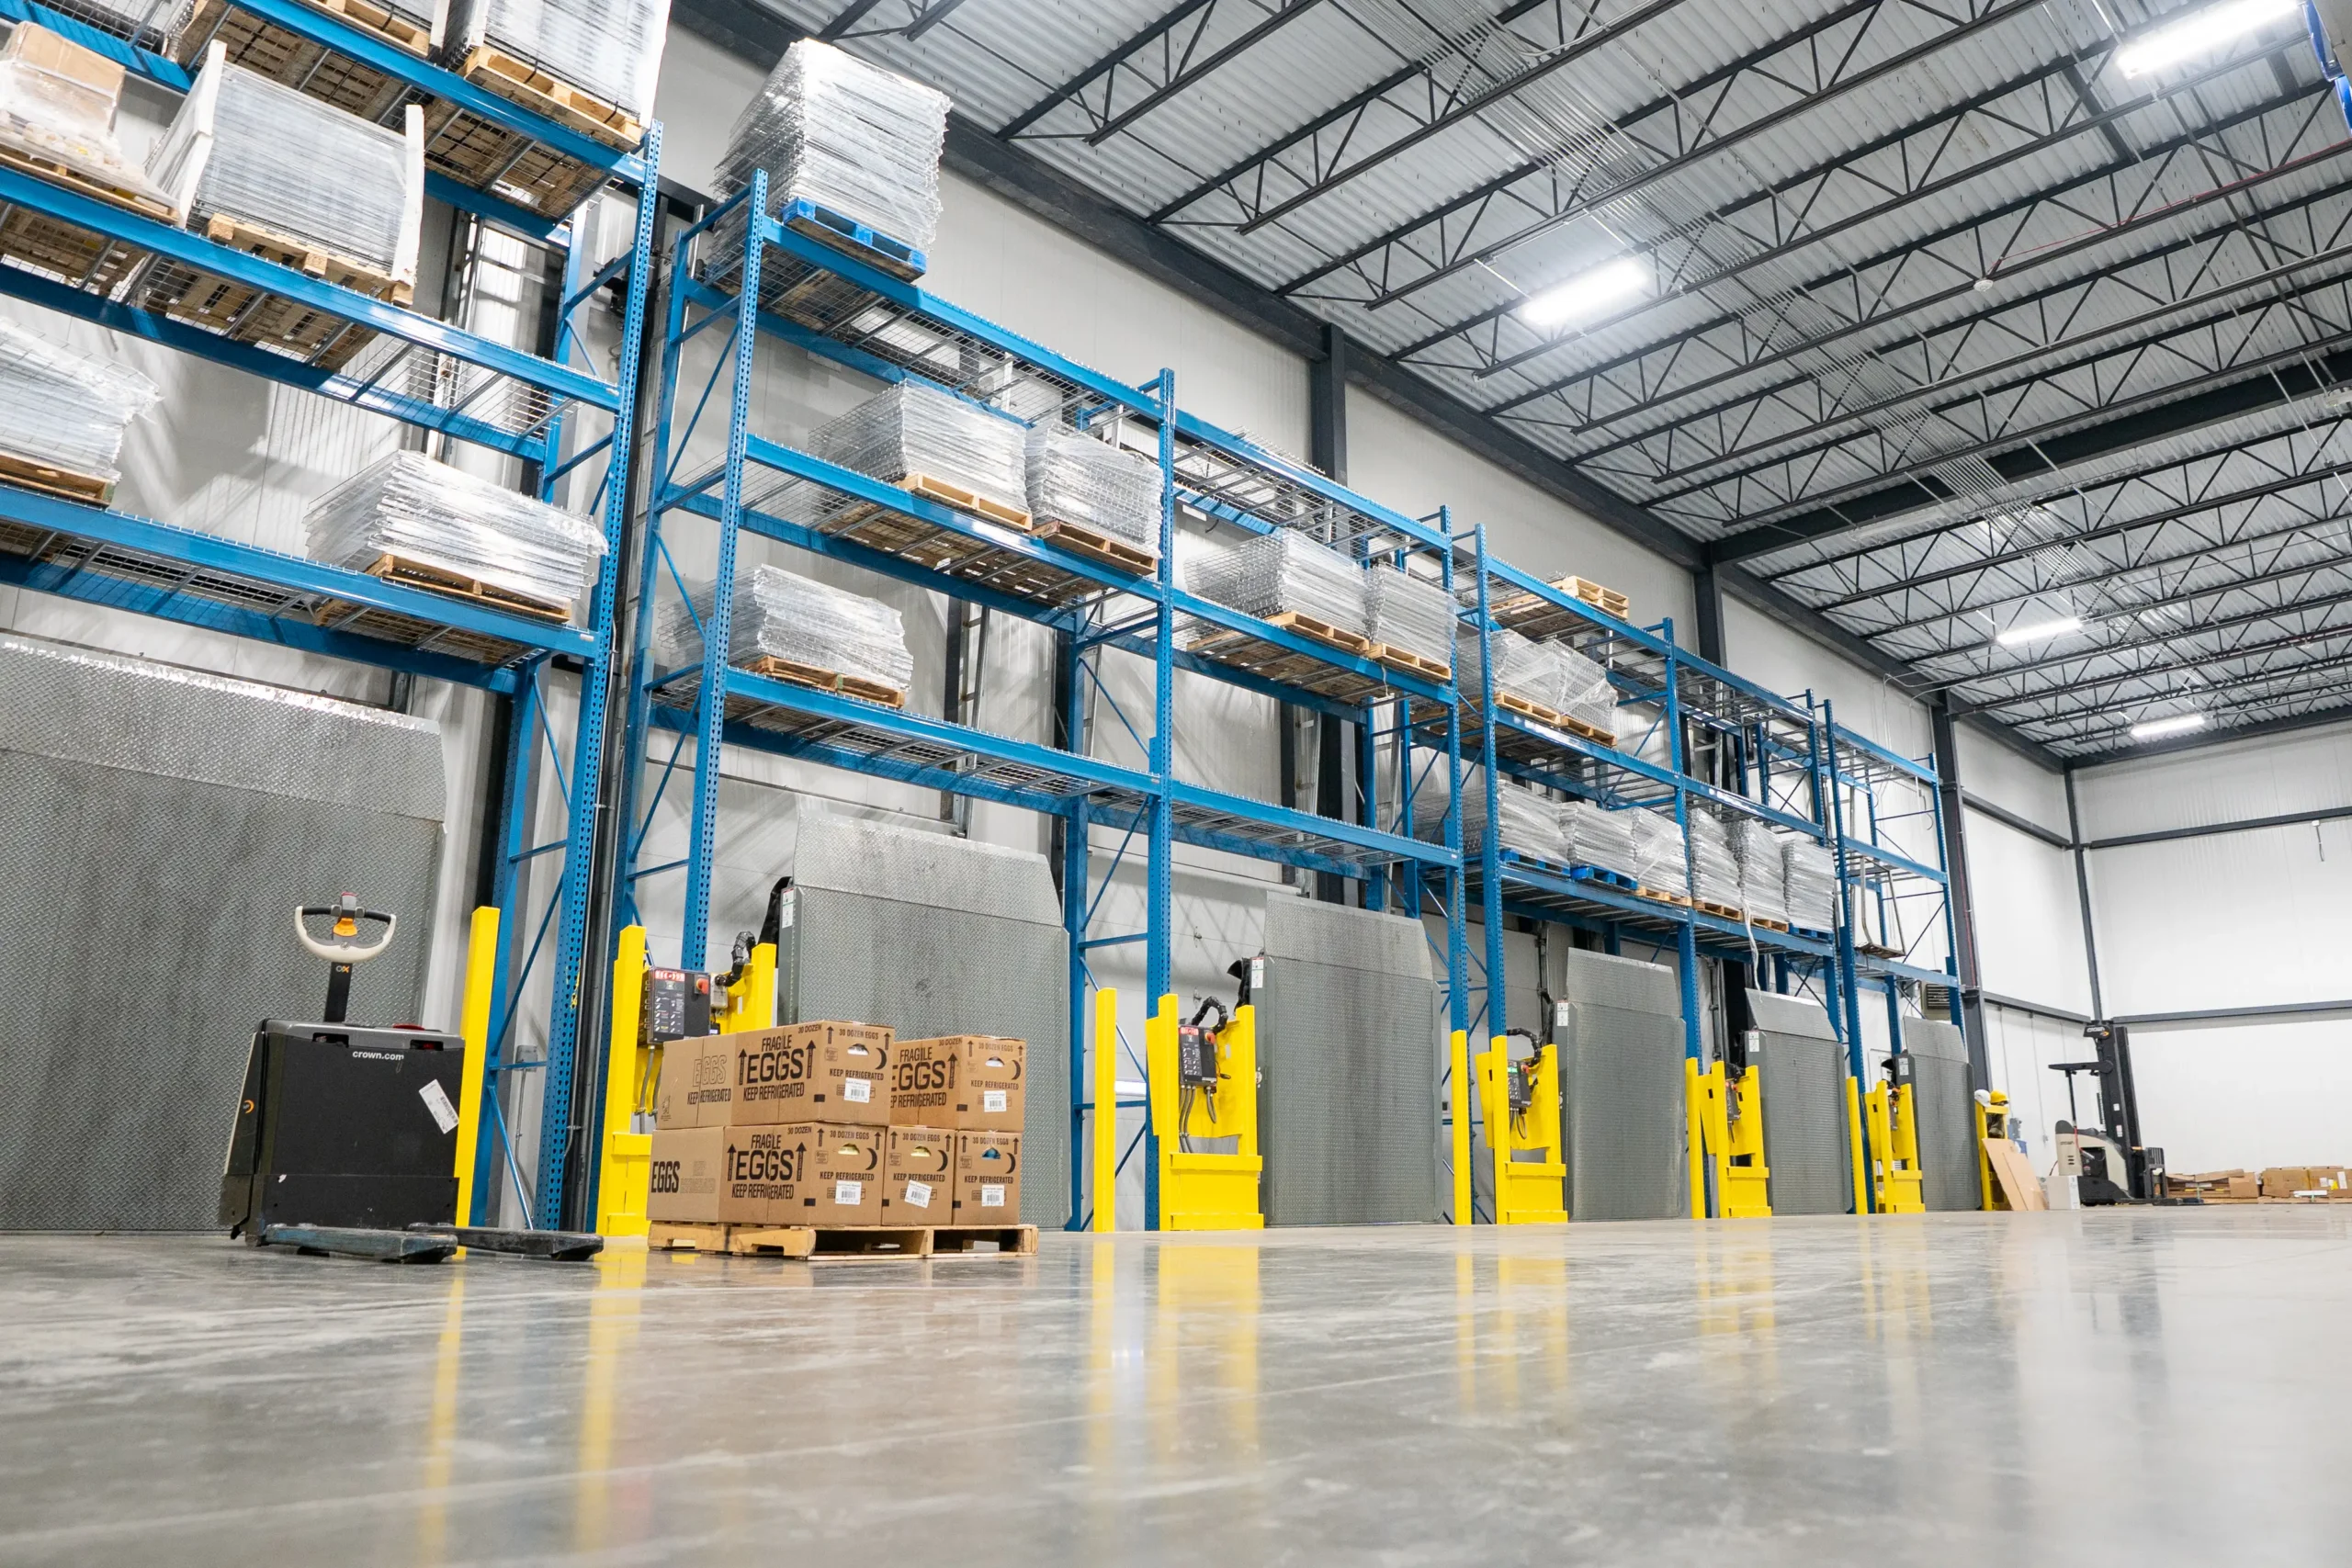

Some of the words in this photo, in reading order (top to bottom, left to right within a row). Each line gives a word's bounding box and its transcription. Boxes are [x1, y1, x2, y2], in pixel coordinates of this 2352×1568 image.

[805, 1023, 822, 1032] DOZEN
[846, 1029, 864, 1038] DOZEN
[865, 1031, 878, 1040] EGGS
[762, 1034, 792, 1052] FRAGLE
[945, 1037, 963, 1045] DOZEN
[985, 1043, 1001, 1051] DOZEN
[352, 1051, 404, 1061] crown.com
[899, 1046, 933, 1063] FRAGILE
[693, 1055, 728, 1088] EGGS
[747, 1048, 805, 1084] EGGS
[829, 1068, 843, 1077] KEEP
[845, 1069, 885, 1081] REFRIGERATED
[970, 1079, 983, 1088] KEEP
[985, 1080, 1020, 1090] REFRIGERATED
[687, 1091, 699, 1105] KEEP
[700, 1088, 732, 1103] REFRIGERATED
[743, 1087, 758, 1102] KEEP
[759, 1082, 805, 1100] REFRIGERATED
[899, 1092, 947, 1108] REFRIGERATED
[787, 1127, 794, 1135] 30
[794, 1126, 812, 1134] DOZEN
[830, 1130, 836, 1138] 30
[837, 1131, 854, 1139] DOZEN
[855, 1132, 869, 1140] EGGS
[752, 1134, 782, 1150] FRAGLE
[902, 1133, 909, 1141] 30
[910, 1134, 926, 1142] DOZEN
[736, 1149, 794, 1181] EGGS
[650, 1161, 680, 1193] EGGS
[820, 1171, 833, 1179] KEEP
[835, 1172, 875, 1181] REFRIGERATED
[893, 1172, 907, 1181] KEEP
[908, 1173, 945, 1183] REFRIGERATED
[979, 1176, 1013, 1184] REFRIGERATED
[731, 1183, 747, 1198] KEEP
[748, 1183, 794, 1200] REFRIGERATED
